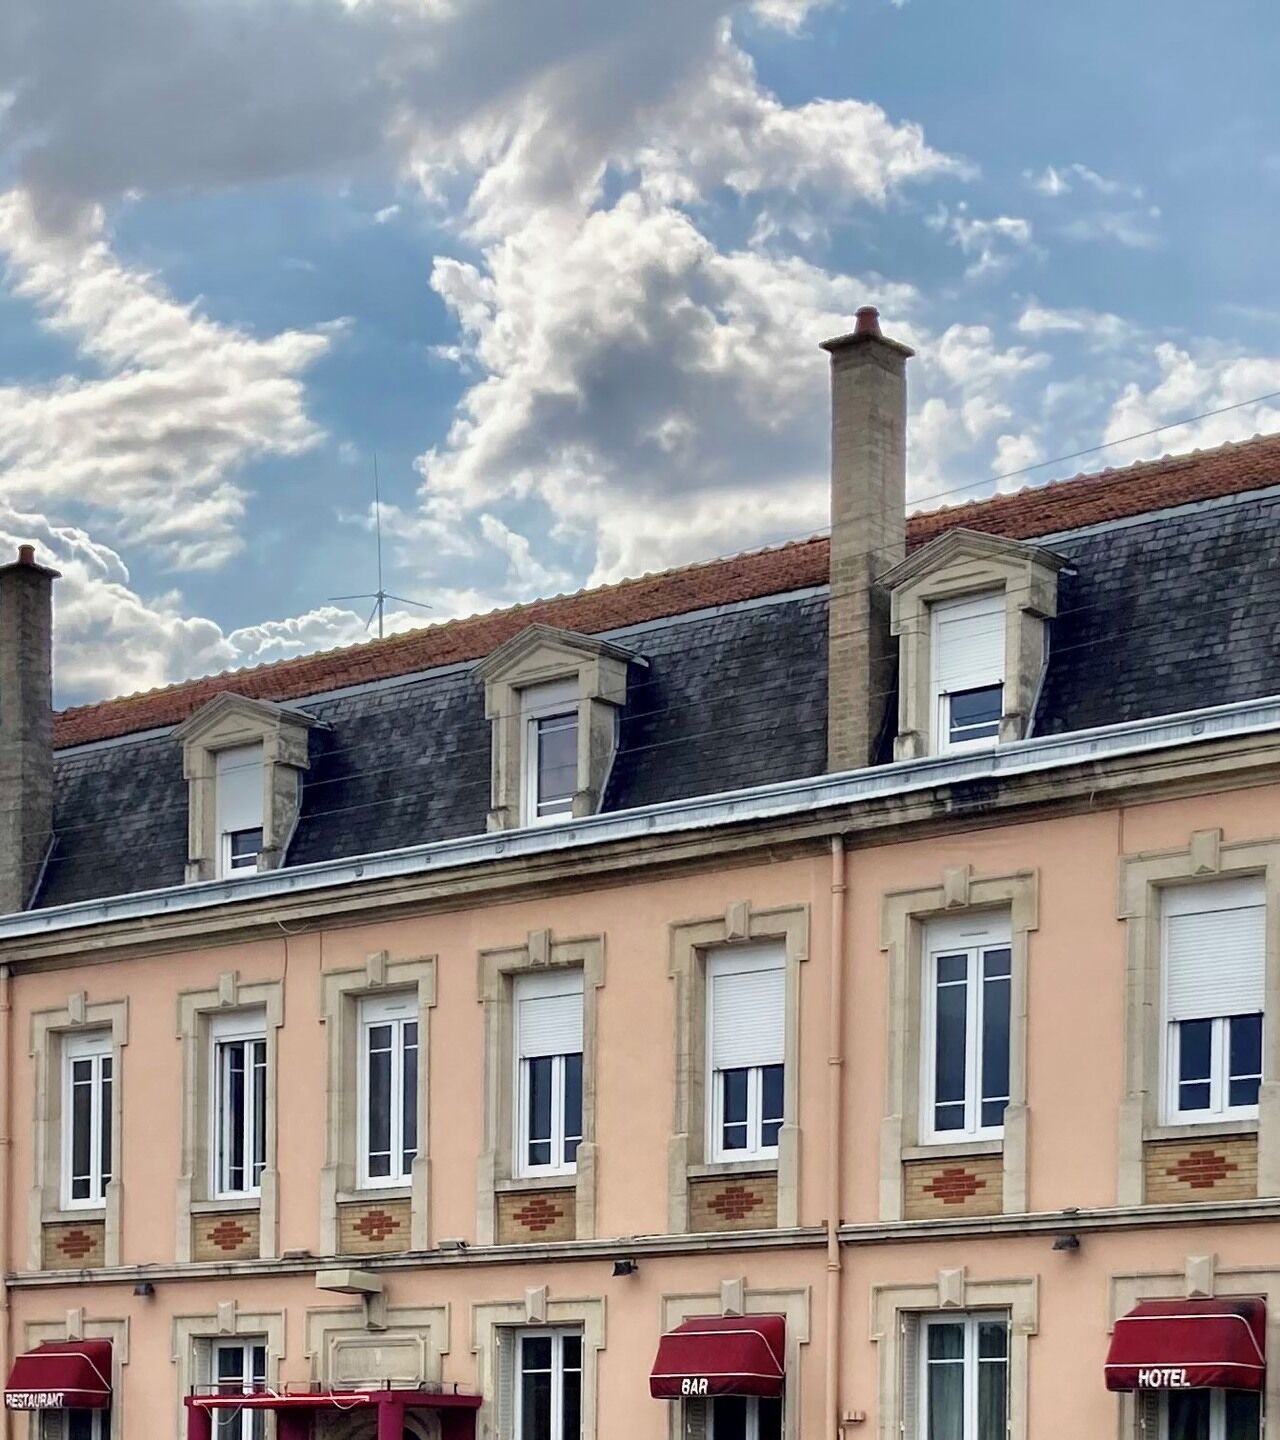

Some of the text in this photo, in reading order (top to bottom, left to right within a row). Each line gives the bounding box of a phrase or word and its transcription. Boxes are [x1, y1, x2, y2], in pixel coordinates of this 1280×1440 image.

[681, 1378, 709, 1395] BAR
[1138, 1368, 1191, 1388] HOTEL
[6, 1393, 64, 1407] RESTAURANT
